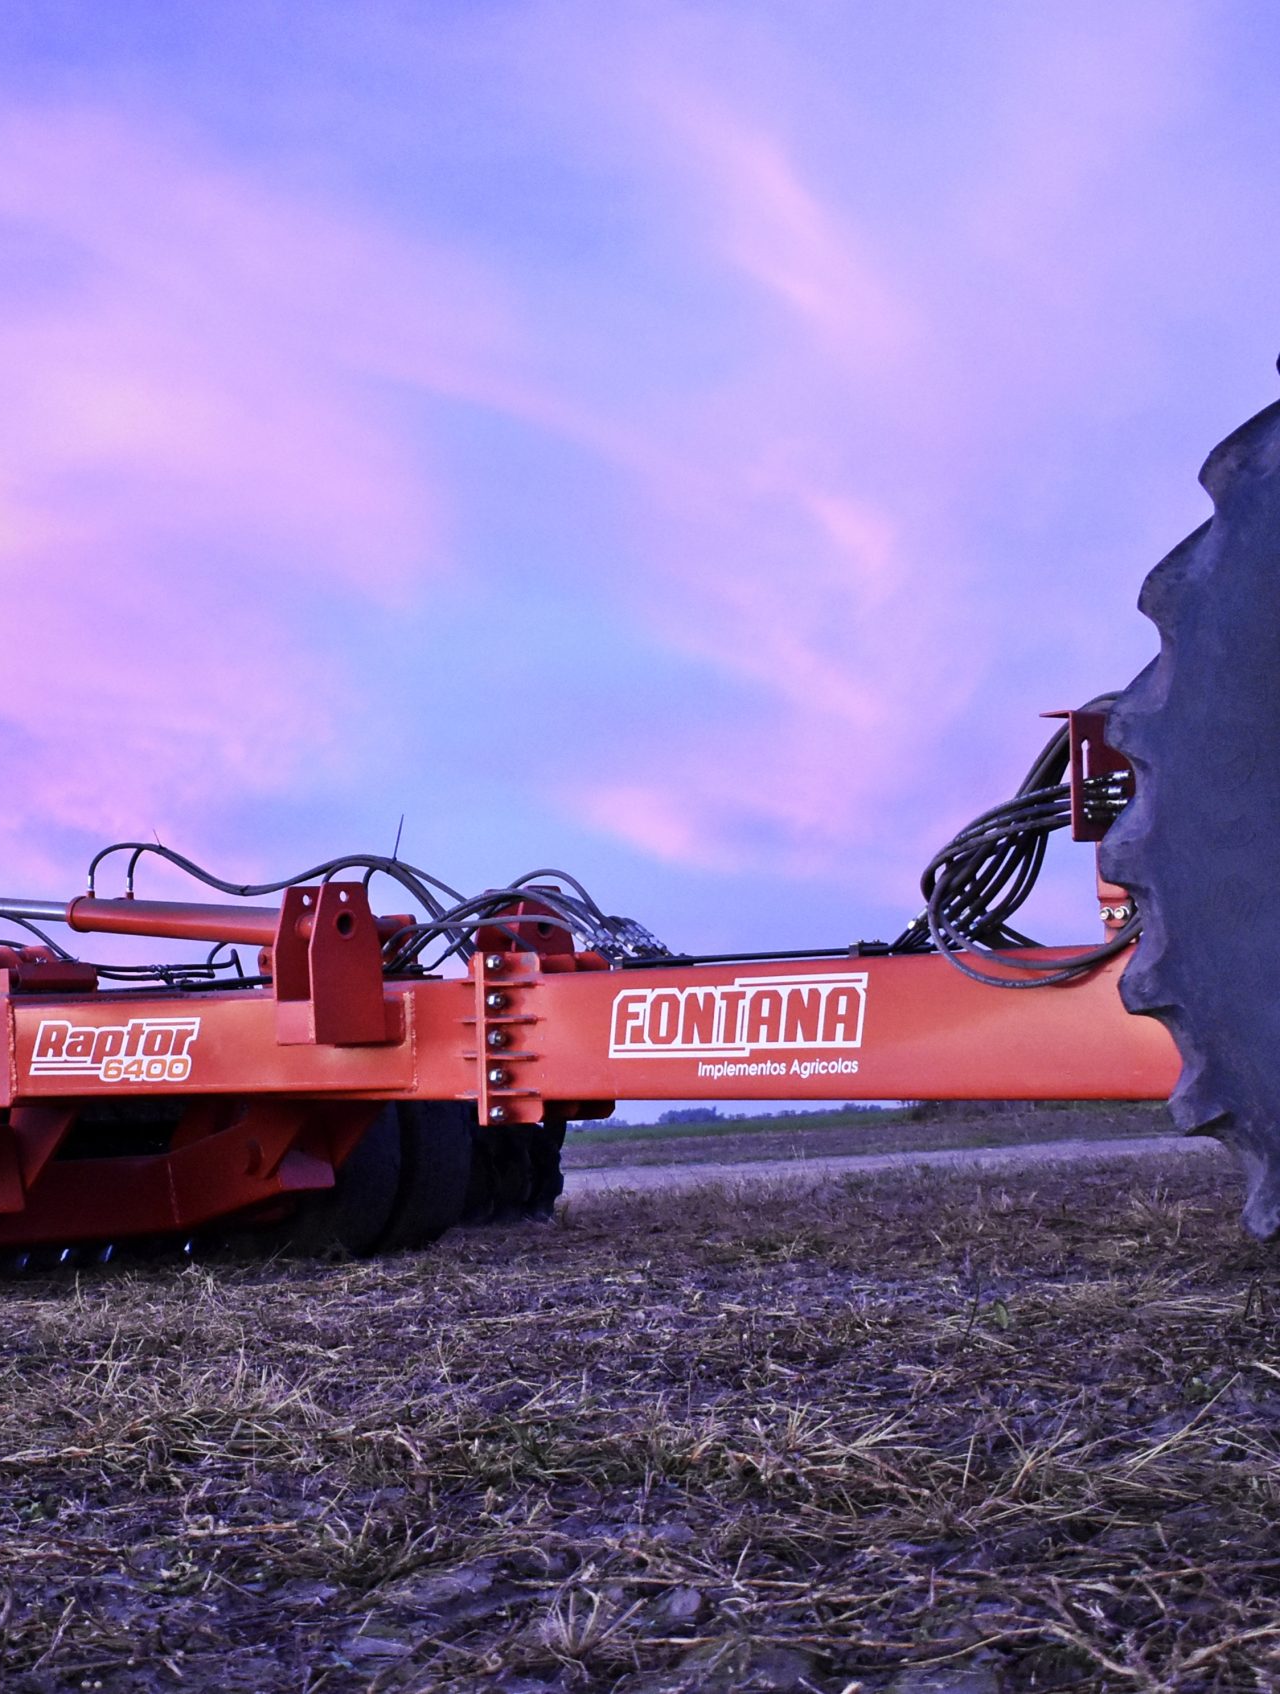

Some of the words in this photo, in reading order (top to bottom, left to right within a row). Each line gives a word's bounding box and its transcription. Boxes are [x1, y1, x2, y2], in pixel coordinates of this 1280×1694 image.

[611, 982, 866, 1048] FONTANA
[33, 1020, 196, 1065] Raptor
[101, 1056, 191, 1081] 6400
[697, 1061, 787, 1079] Implementos
[789, 1058, 859, 1079] Agricolas
